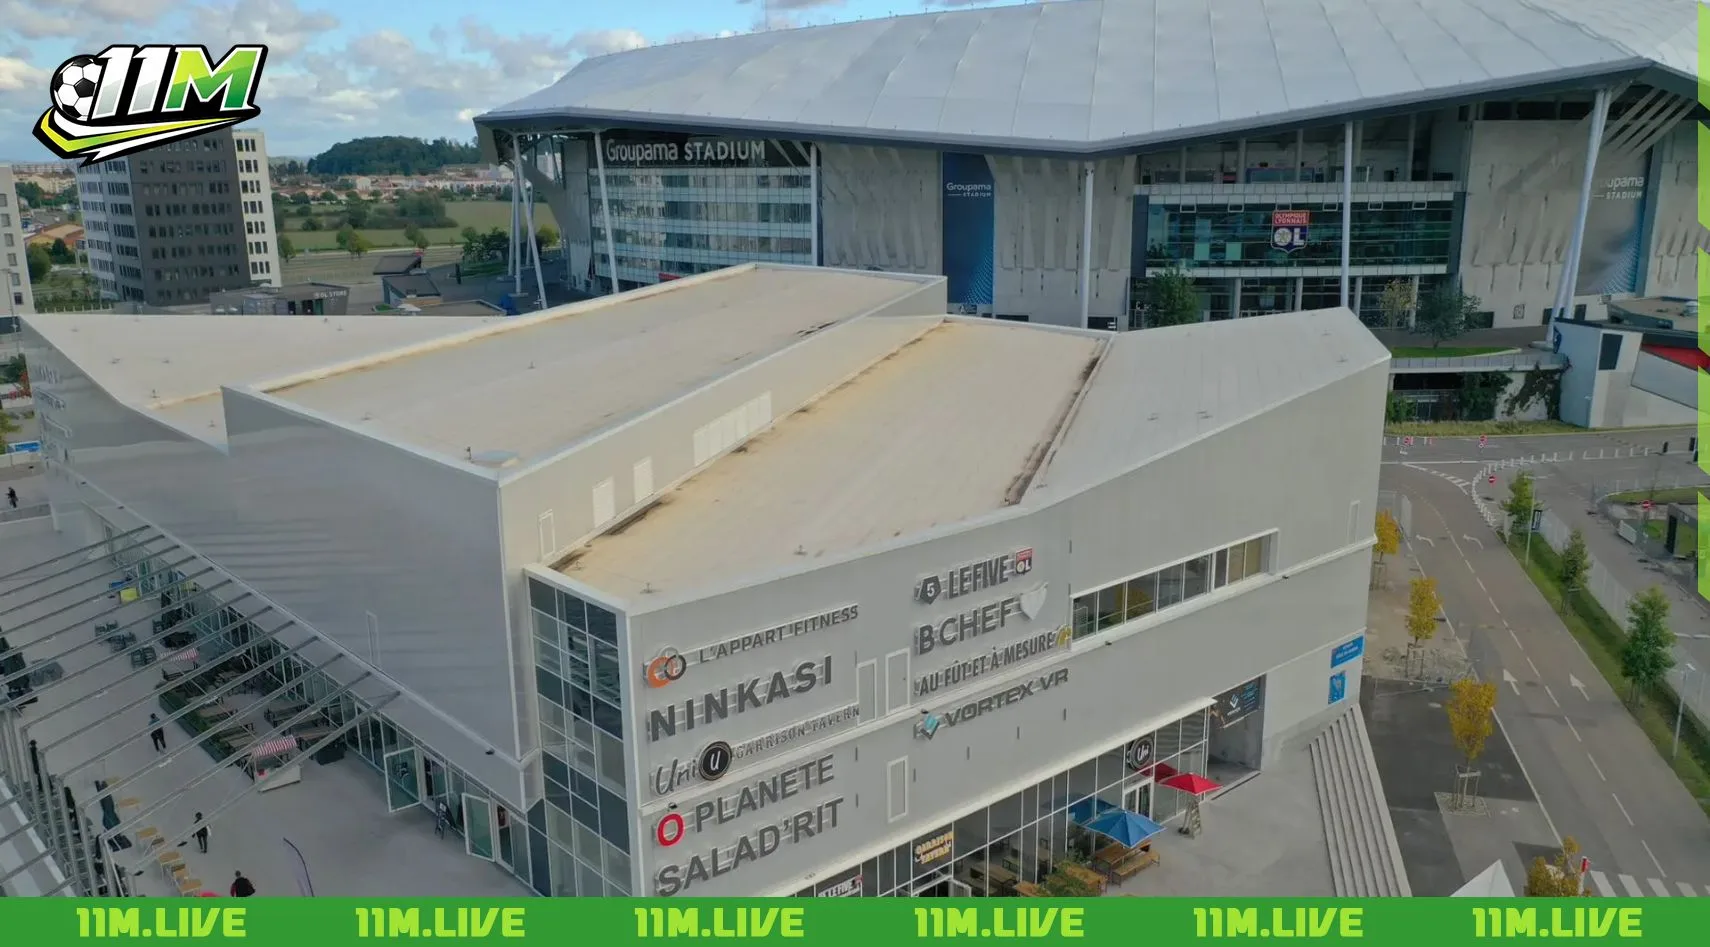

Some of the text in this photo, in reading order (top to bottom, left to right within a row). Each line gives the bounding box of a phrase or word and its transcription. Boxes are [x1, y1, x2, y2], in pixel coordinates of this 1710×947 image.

[606, 138, 766, 167] Groupama STADIUM
[946, 182, 992, 192] Groupama
[1606, 191, 1643, 200] STADIUM
[1274, 228, 1305, 246] OL
[926, 582, 935, 597] 5
[699, 604, 859, 664] L'APPART FITNESS
[919, 596, 1017, 655] BCHEF
[919, 631, 1054, 696] AU FÛT ET À MESURE
[650, 655, 832, 742] NINKASI
[945, 667, 1069, 727] VORTEX VR
[655, 758, 698, 796] Uni
[737, 723, 805, 760] GARRISON
[811, 705, 860, 731] TAVERN
[656, 753, 835, 847] O PLANETE
[658, 797, 844, 897] SALAD'RIT
